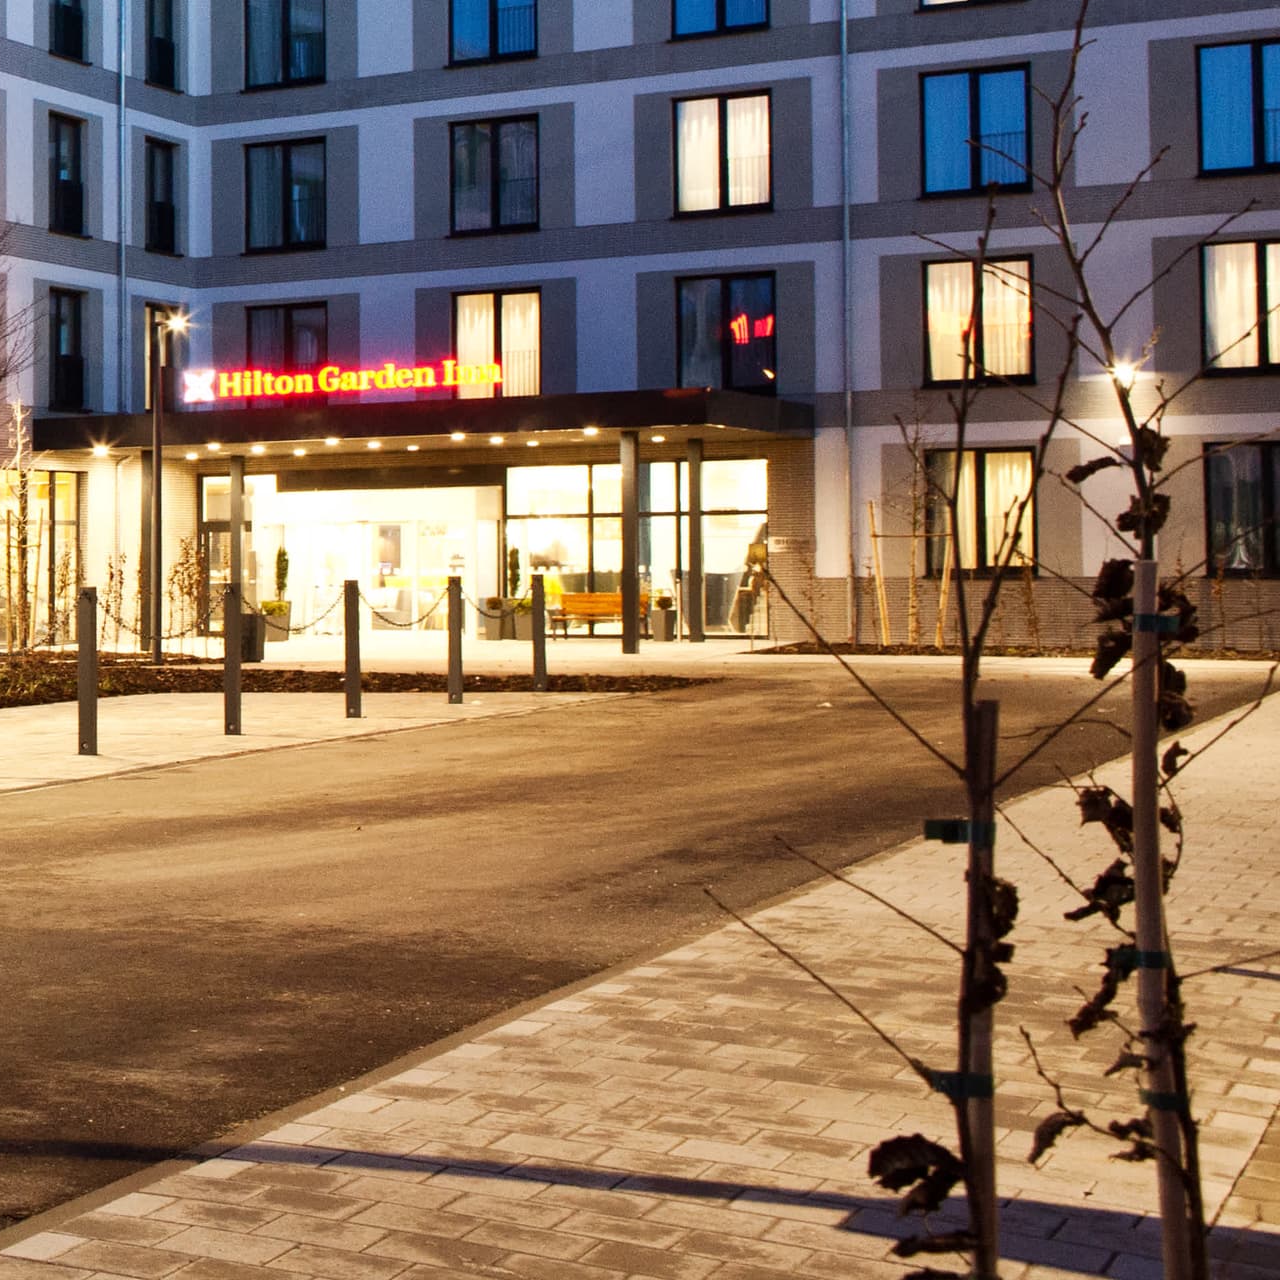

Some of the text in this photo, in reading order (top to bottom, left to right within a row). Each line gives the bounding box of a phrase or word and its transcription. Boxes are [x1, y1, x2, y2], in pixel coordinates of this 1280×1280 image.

[218, 359, 504, 398] Hilton Garden Inn
